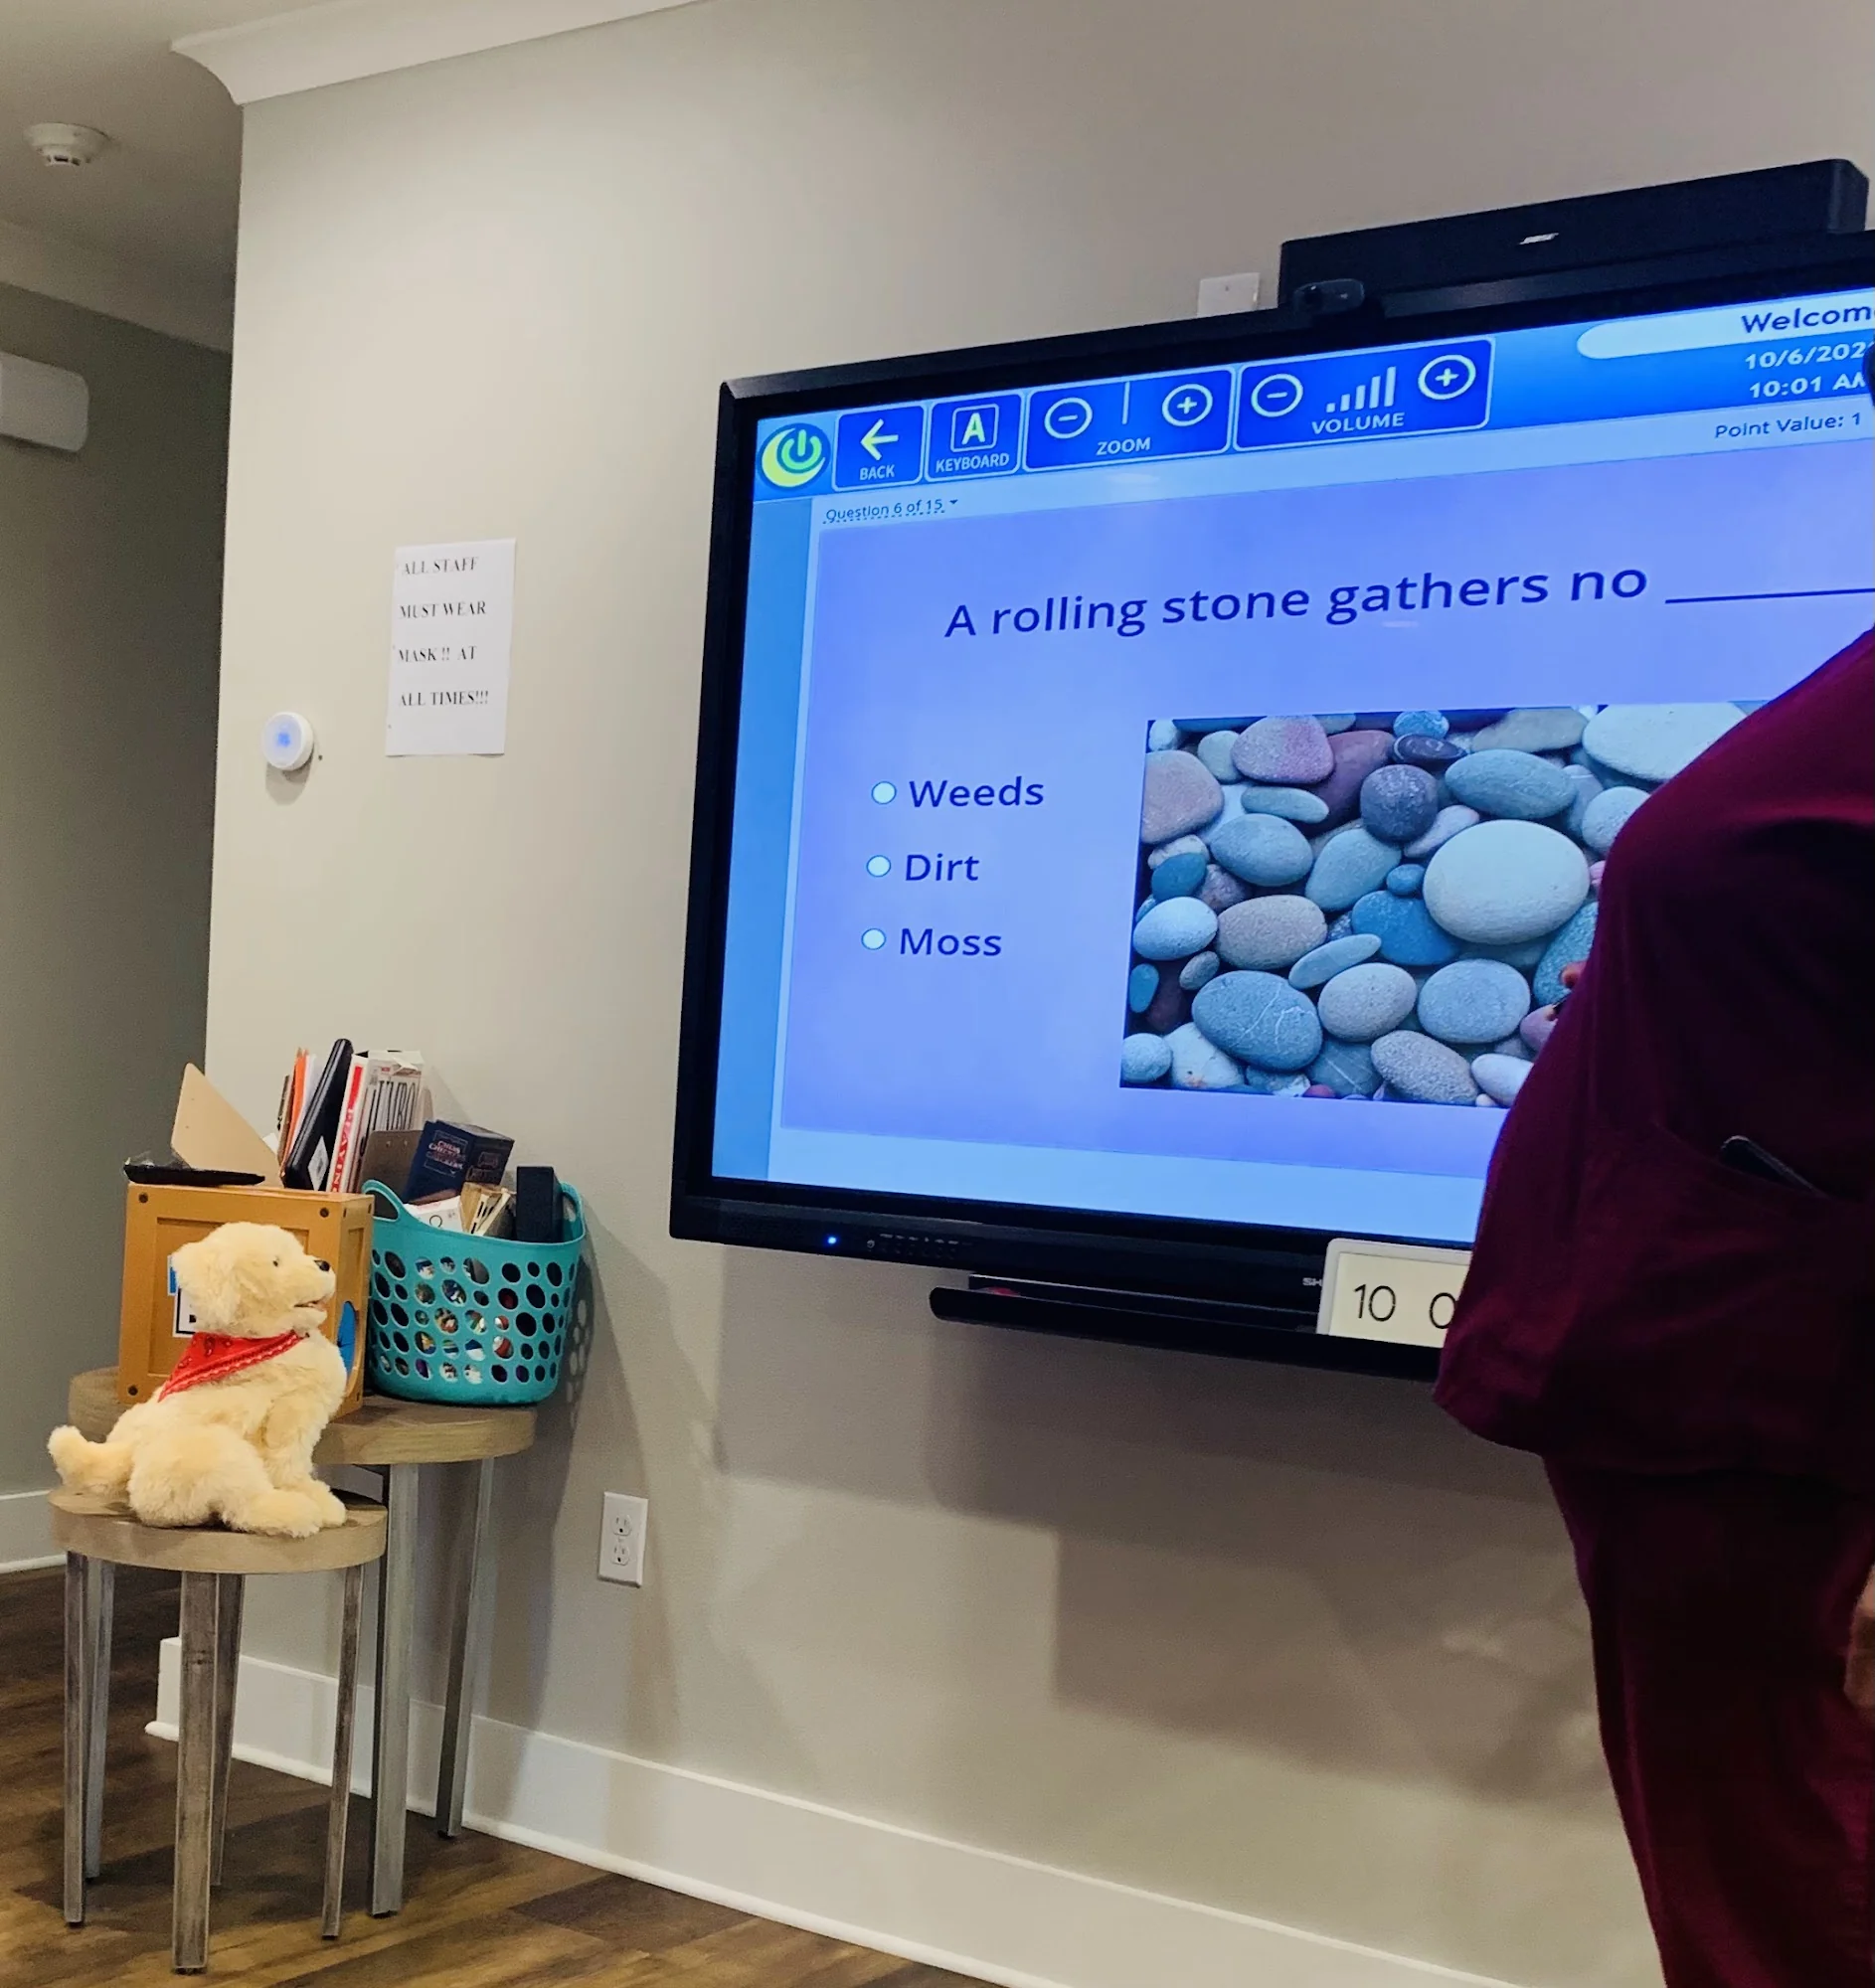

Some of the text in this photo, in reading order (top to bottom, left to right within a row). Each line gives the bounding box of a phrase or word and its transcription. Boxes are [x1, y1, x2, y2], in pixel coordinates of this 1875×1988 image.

[1741, 306, 1874, 333] Welcom
[1745, 341, 1874, 370] 10/6/202
[1750, 371, 1866, 398] 10:01 AM
[961, 412, 985, 445] A
[1311, 413, 1405, 434] VOLUME
[1715, 412, 1861, 439] Point Value: 1
[1096, 436, 1151, 456] ZOOM
[859, 464, 896, 481] BACK
[936, 452, 1010, 473] KEYBOARD
[825, 498, 942, 524] Question 6 of 15
[402, 556, 479, 576] ALL STAFF
[399, 599, 487, 619] MUST WEAR
[944, 570, 1647, 637] A rolling stone gathers no
[398, 647, 436, 663] MASK
[456, 645, 476, 661] AT
[399, 690, 489, 707] ALL TIMES!!!
[909, 775, 1045, 808] Weeds
[906, 853, 979, 882] Dirt
[900, 927, 1002, 957] Moss
[1353, 1283, 1397, 1323] 10
